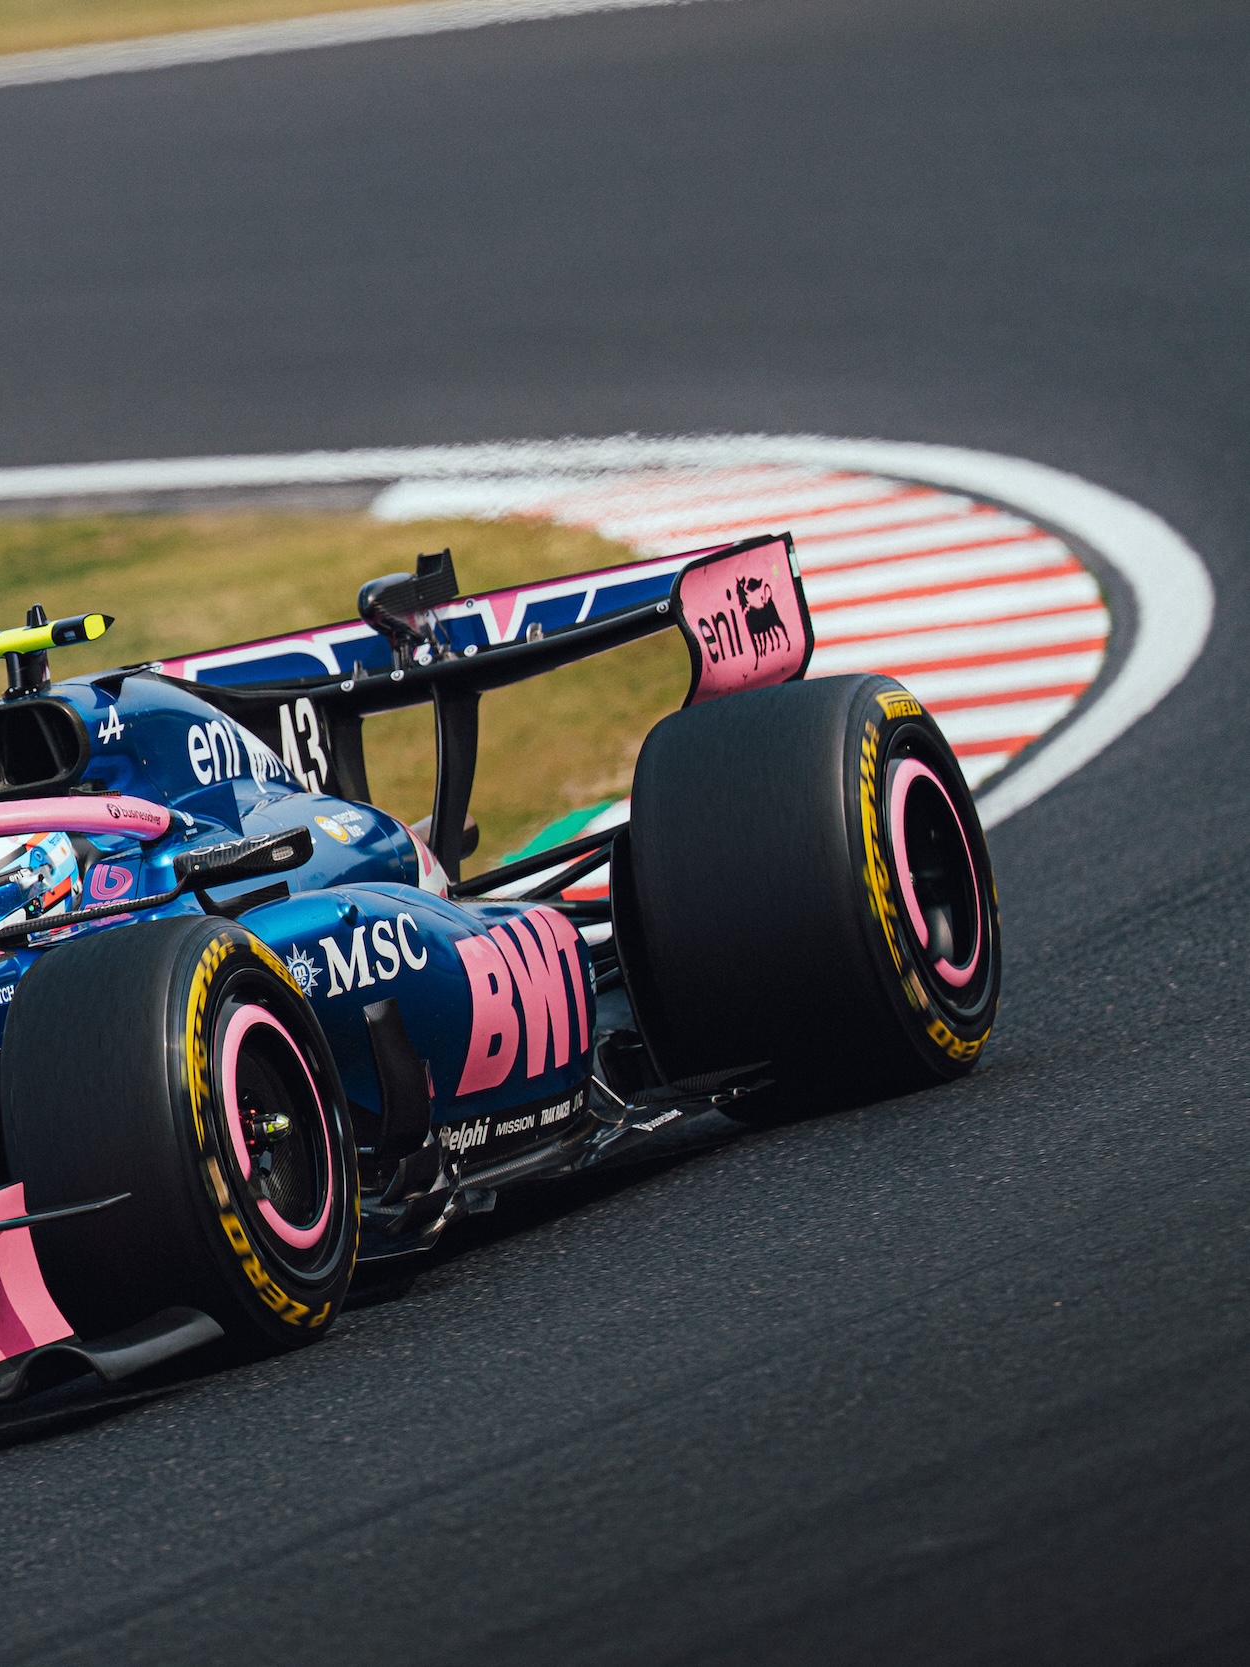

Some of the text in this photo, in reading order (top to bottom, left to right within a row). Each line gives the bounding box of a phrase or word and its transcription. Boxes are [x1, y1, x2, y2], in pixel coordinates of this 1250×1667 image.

[698, 588, 744, 664] eni
[875, 690, 923, 720] PIRELLI
[187, 707, 241, 785] eni
[279, 697, 328, 794] 43
[319, 912, 428, 998] MSC
[454, 904, 589, 1096] BWT
[495, 1114, 535, 1137] MISSION
